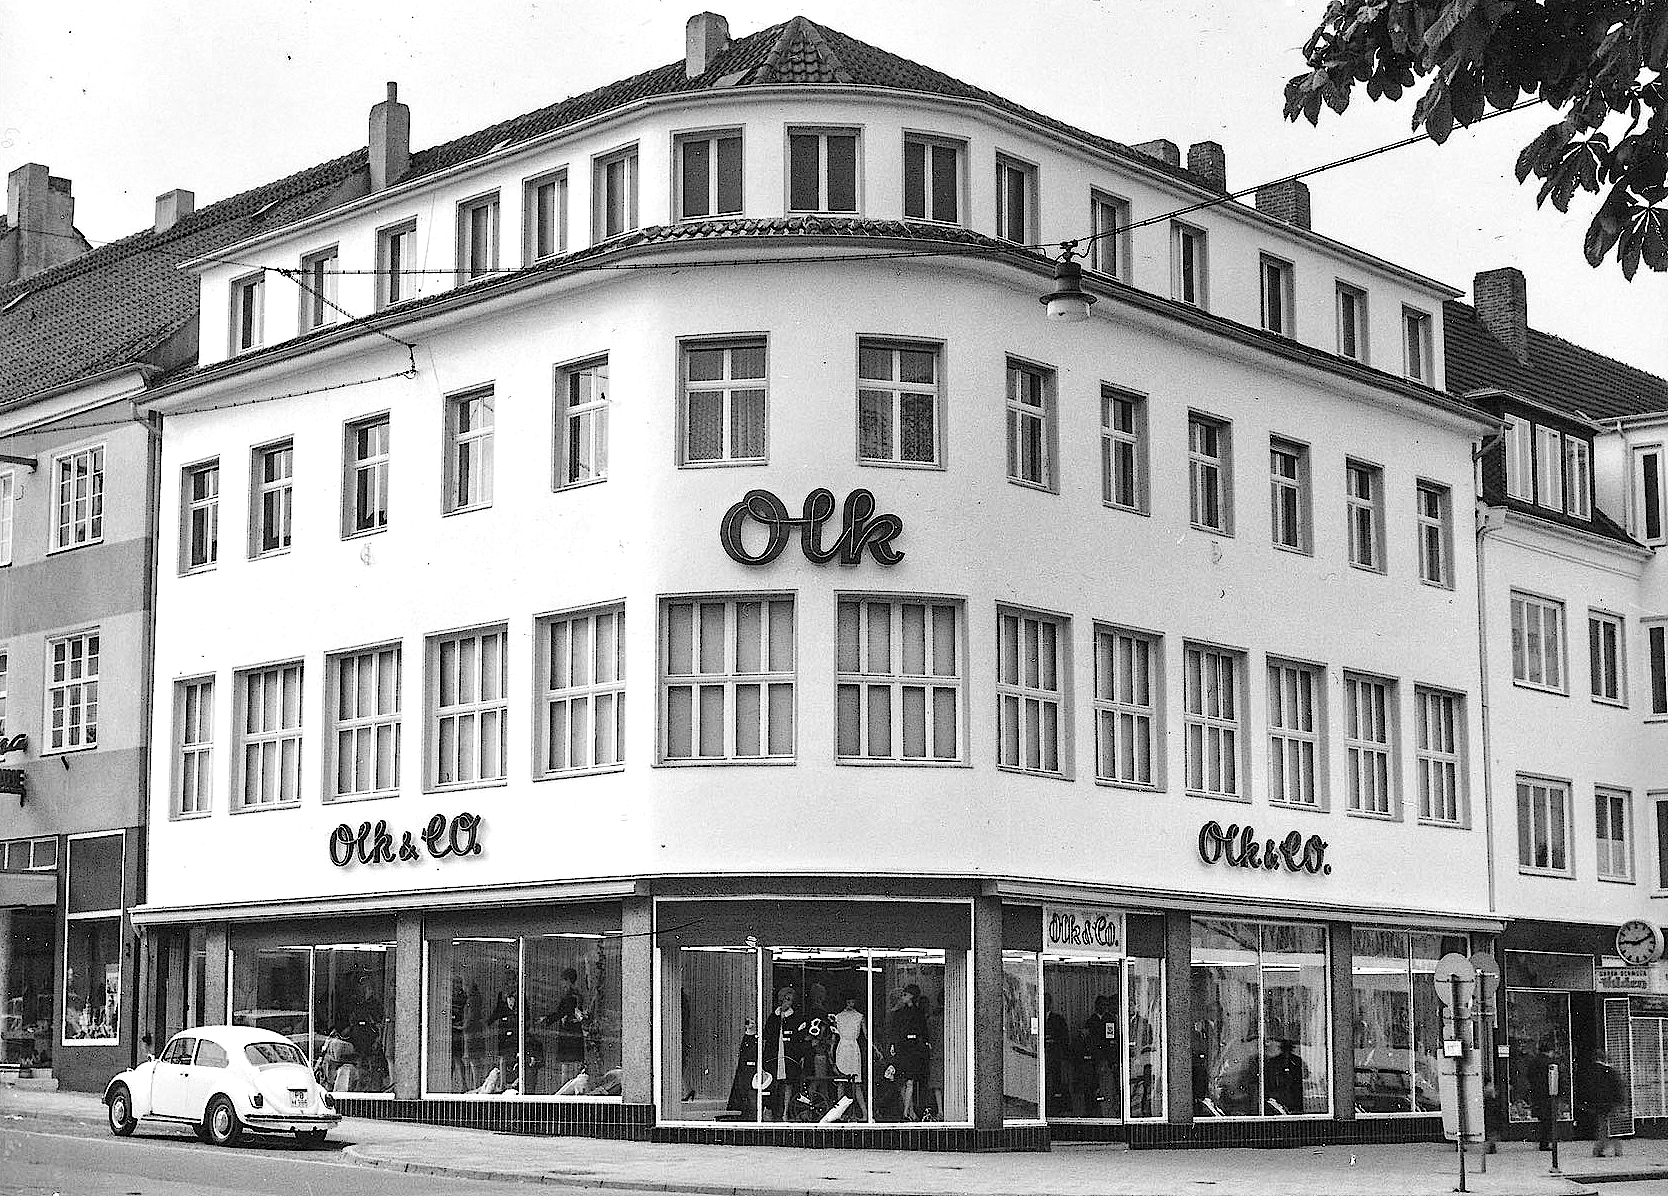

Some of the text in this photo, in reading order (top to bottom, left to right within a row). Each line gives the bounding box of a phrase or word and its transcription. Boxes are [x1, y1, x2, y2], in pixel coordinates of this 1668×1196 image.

[720, 488, 905, 565] Olk
[329, 819, 396, 867] Olk
[399, 831, 419, 862] &
[1199, 820, 1262, 868] Olk
[1263, 838, 1279, 870] &
[1049, 912, 1081, 945] Olk
